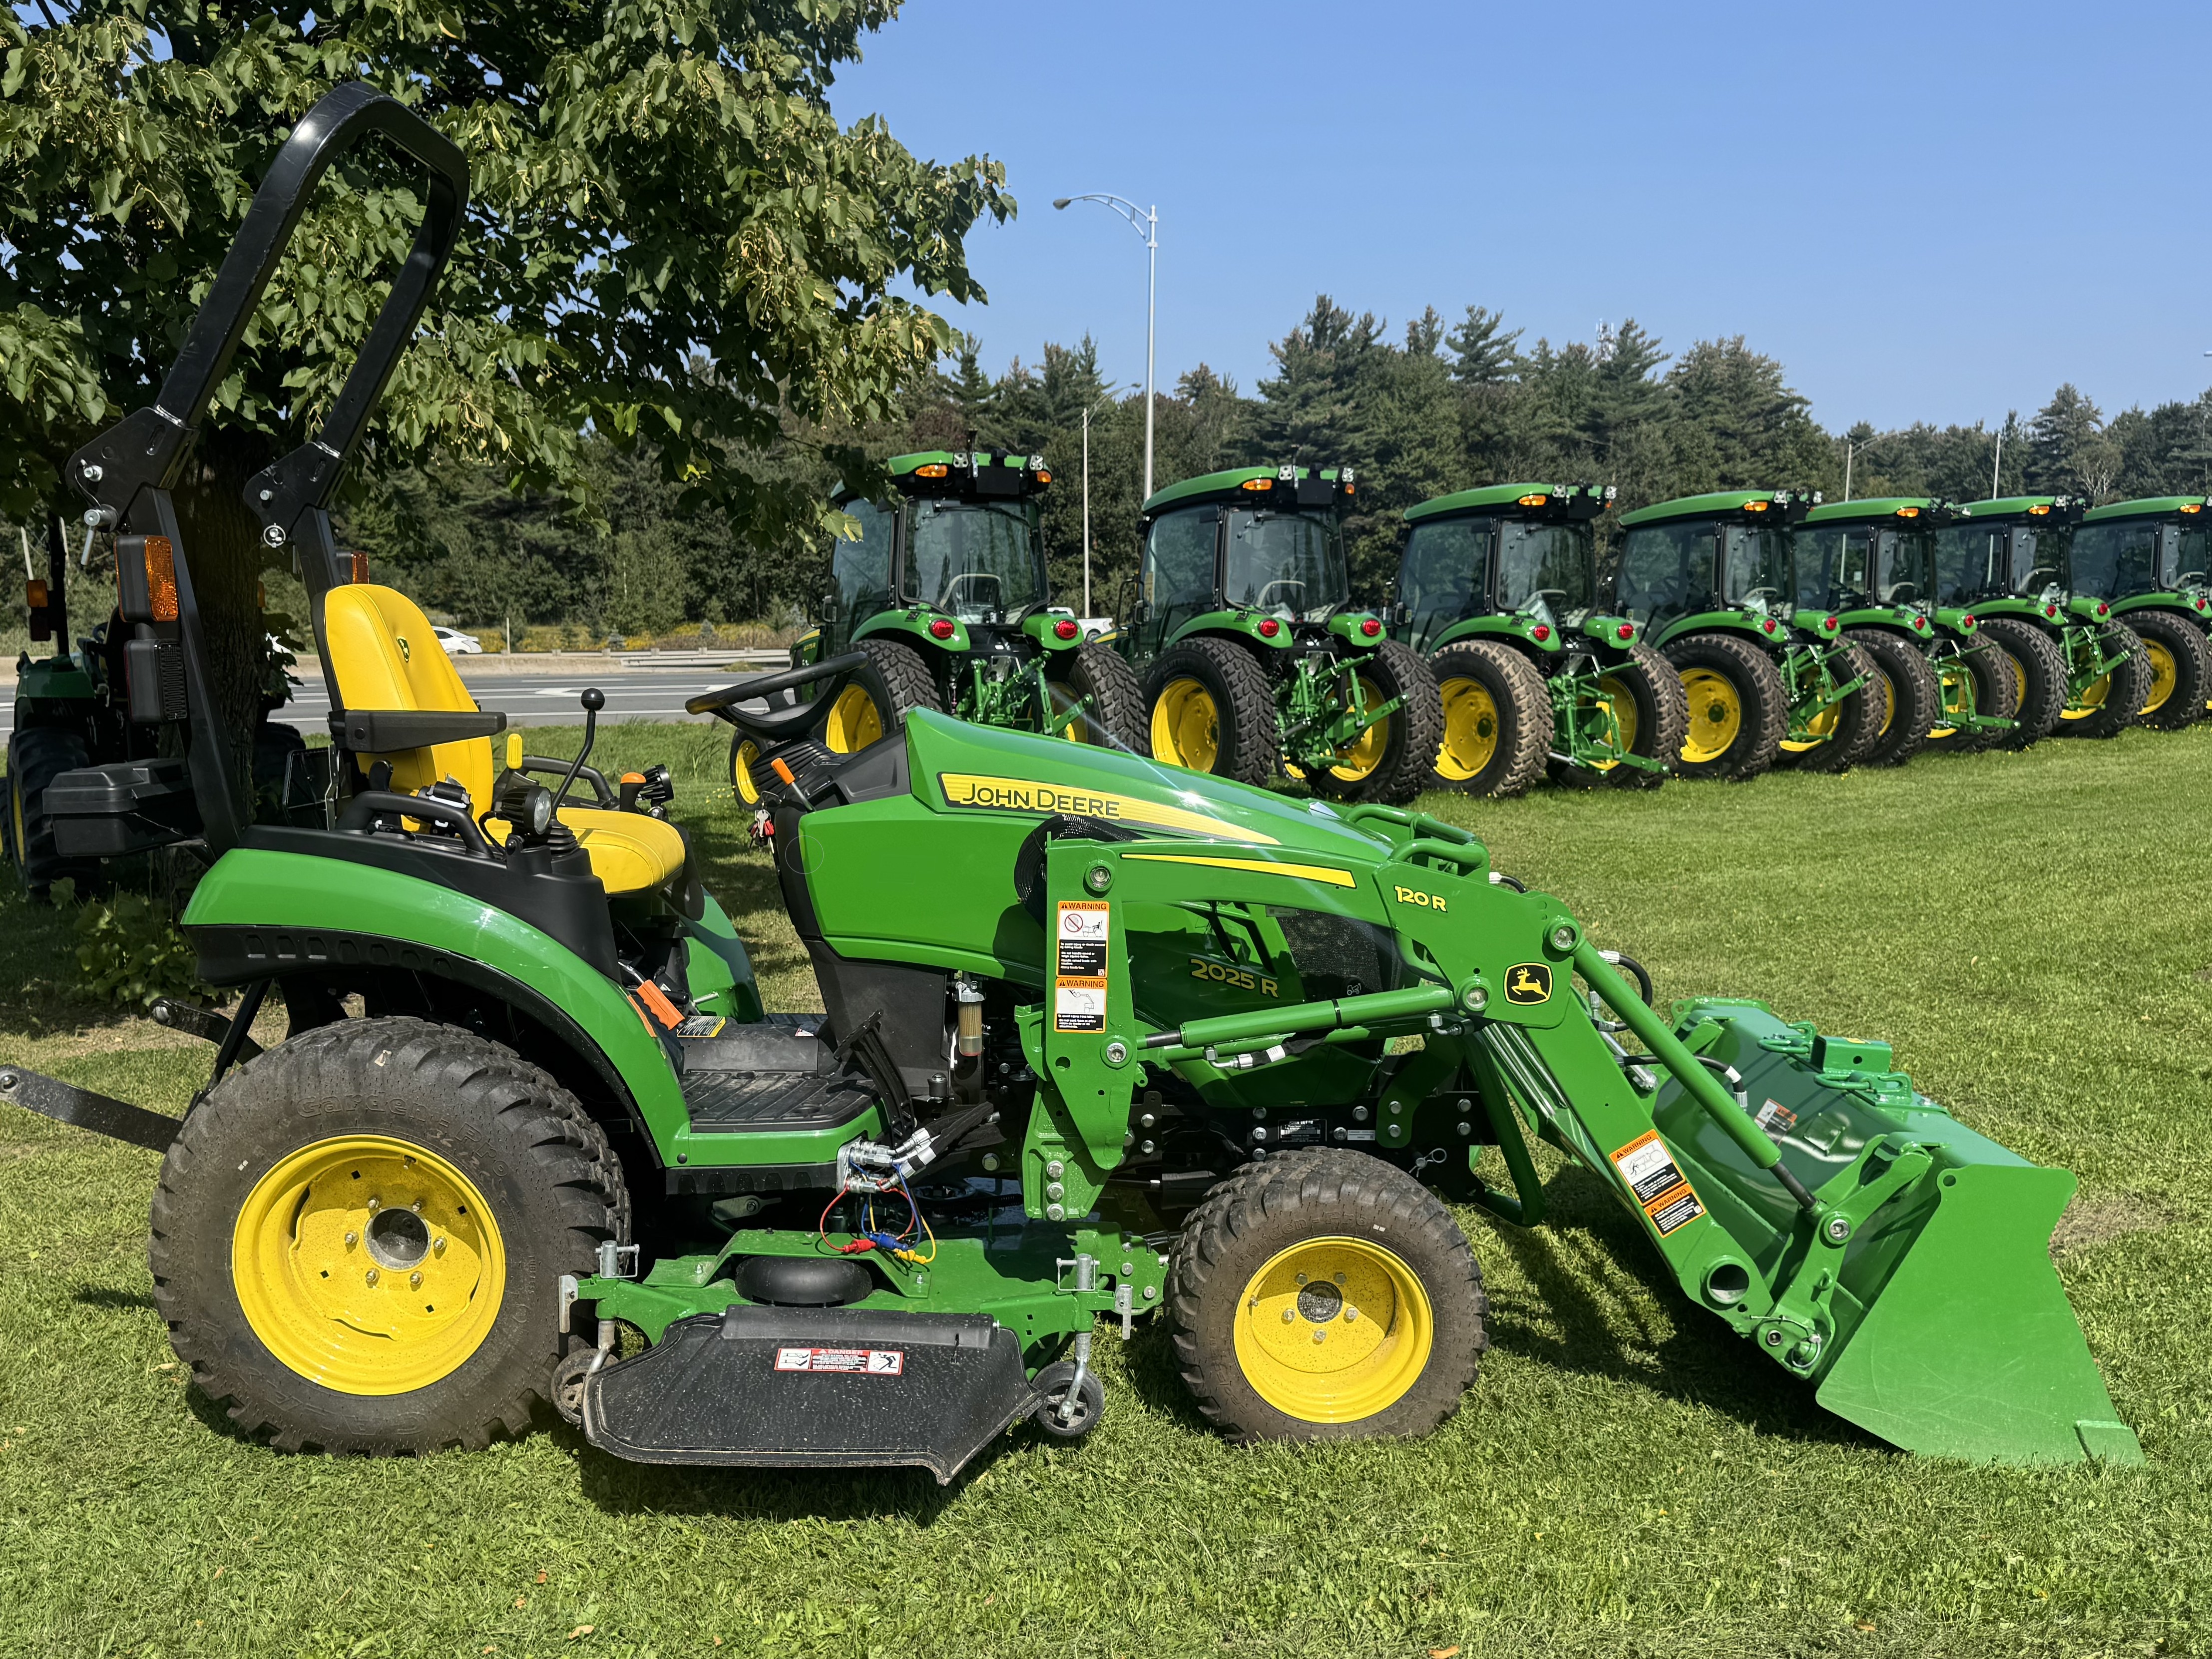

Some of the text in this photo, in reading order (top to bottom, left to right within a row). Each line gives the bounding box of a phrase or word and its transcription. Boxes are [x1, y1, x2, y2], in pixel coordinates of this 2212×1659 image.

[962, 783, 1120, 817] JOHN DEERE
[1068, 902, 1107, 910] WARNING
[1394, 885, 1447, 912] 120 R
[1191, 958, 1279, 998] 2025 R
[1622, 1134, 1652, 1155] WARNING
[1658, 1188, 1688, 1208] WARNING
